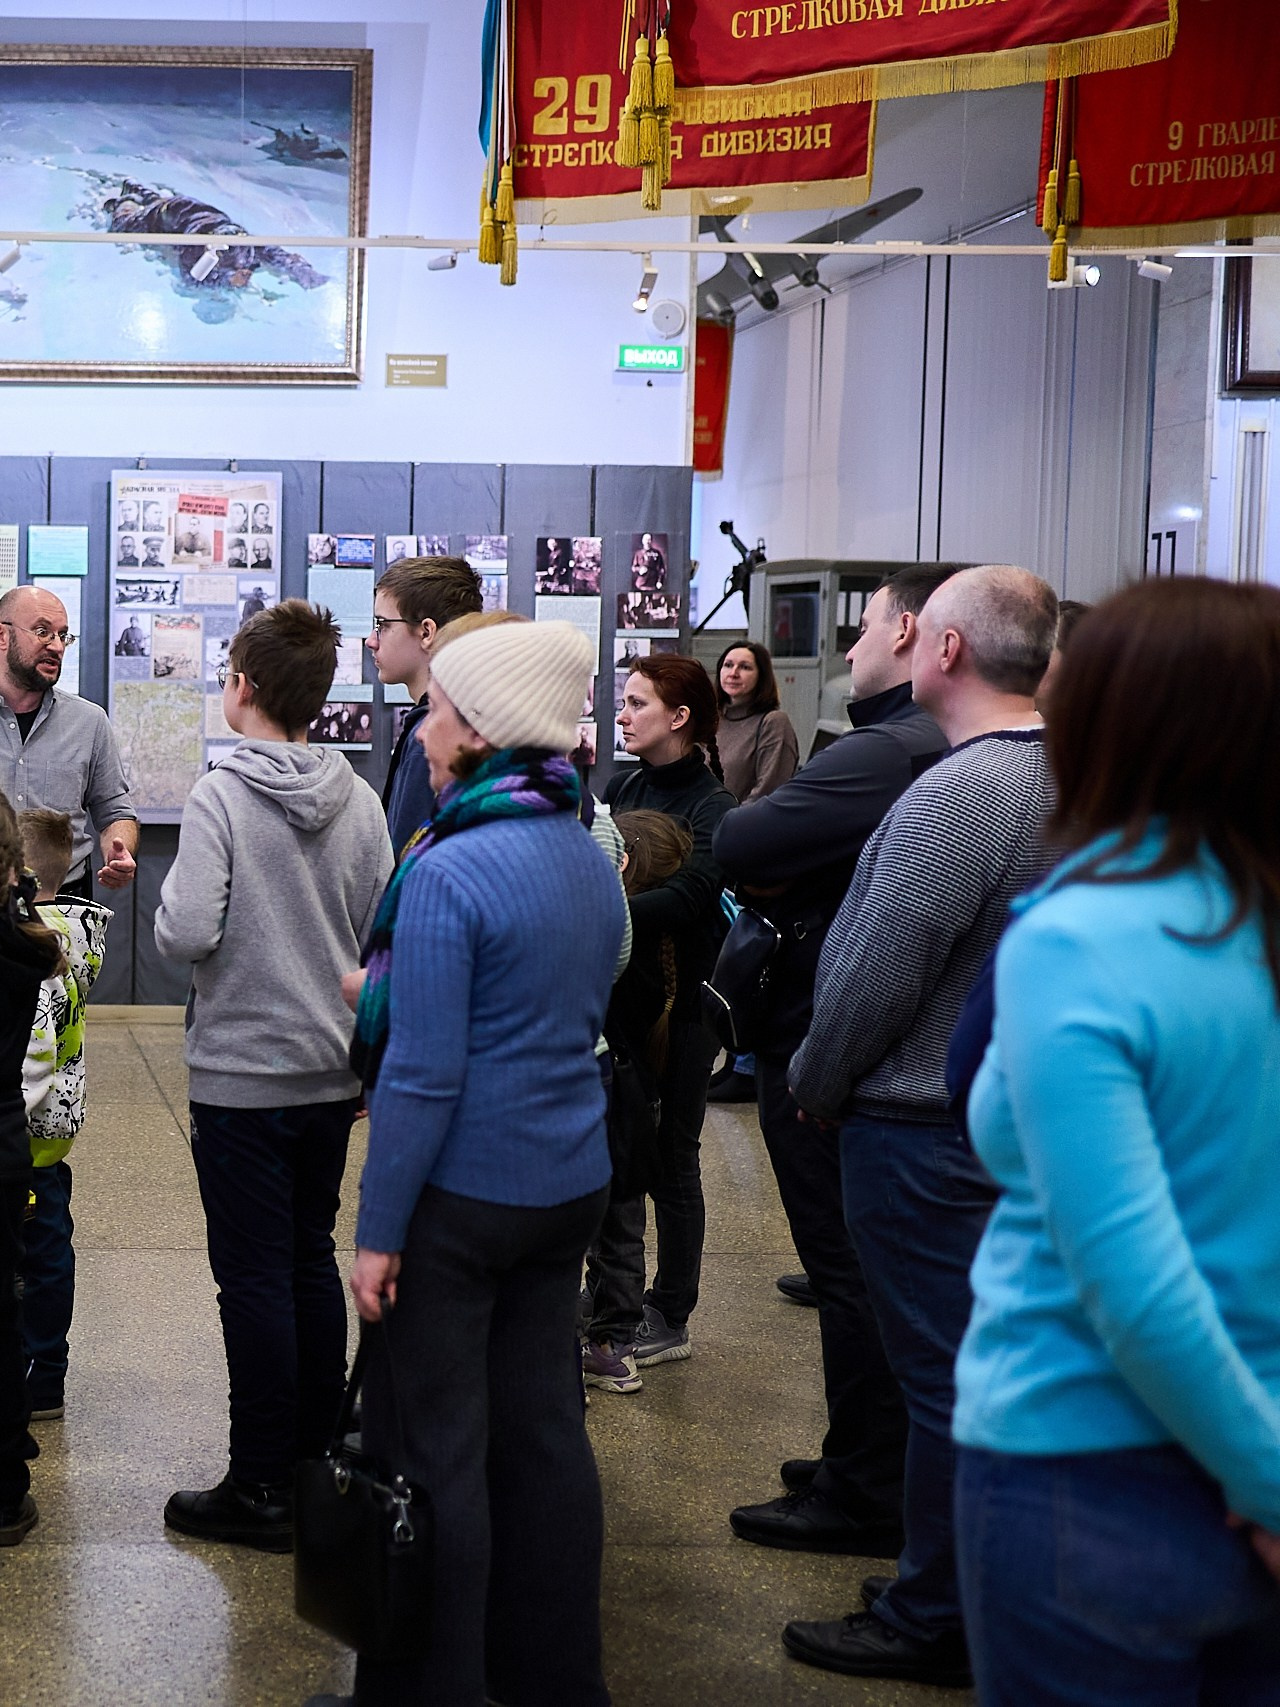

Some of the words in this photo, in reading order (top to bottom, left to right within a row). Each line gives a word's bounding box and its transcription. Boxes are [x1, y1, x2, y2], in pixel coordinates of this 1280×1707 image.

[731, 0, 903, 39] СТРЕЛКОВАЯ
[533, 74, 612, 136] 29
[512, 136, 683, 168] СТРЕЛКЯ
[700, 123, 832, 159] ДИВИЗИЯ
[1168, 121, 1184, 150] 9
[1130, 151, 1276, 187] СТРЕЛКОВАЯ
[624, 349, 679, 367] ВЫХОД
